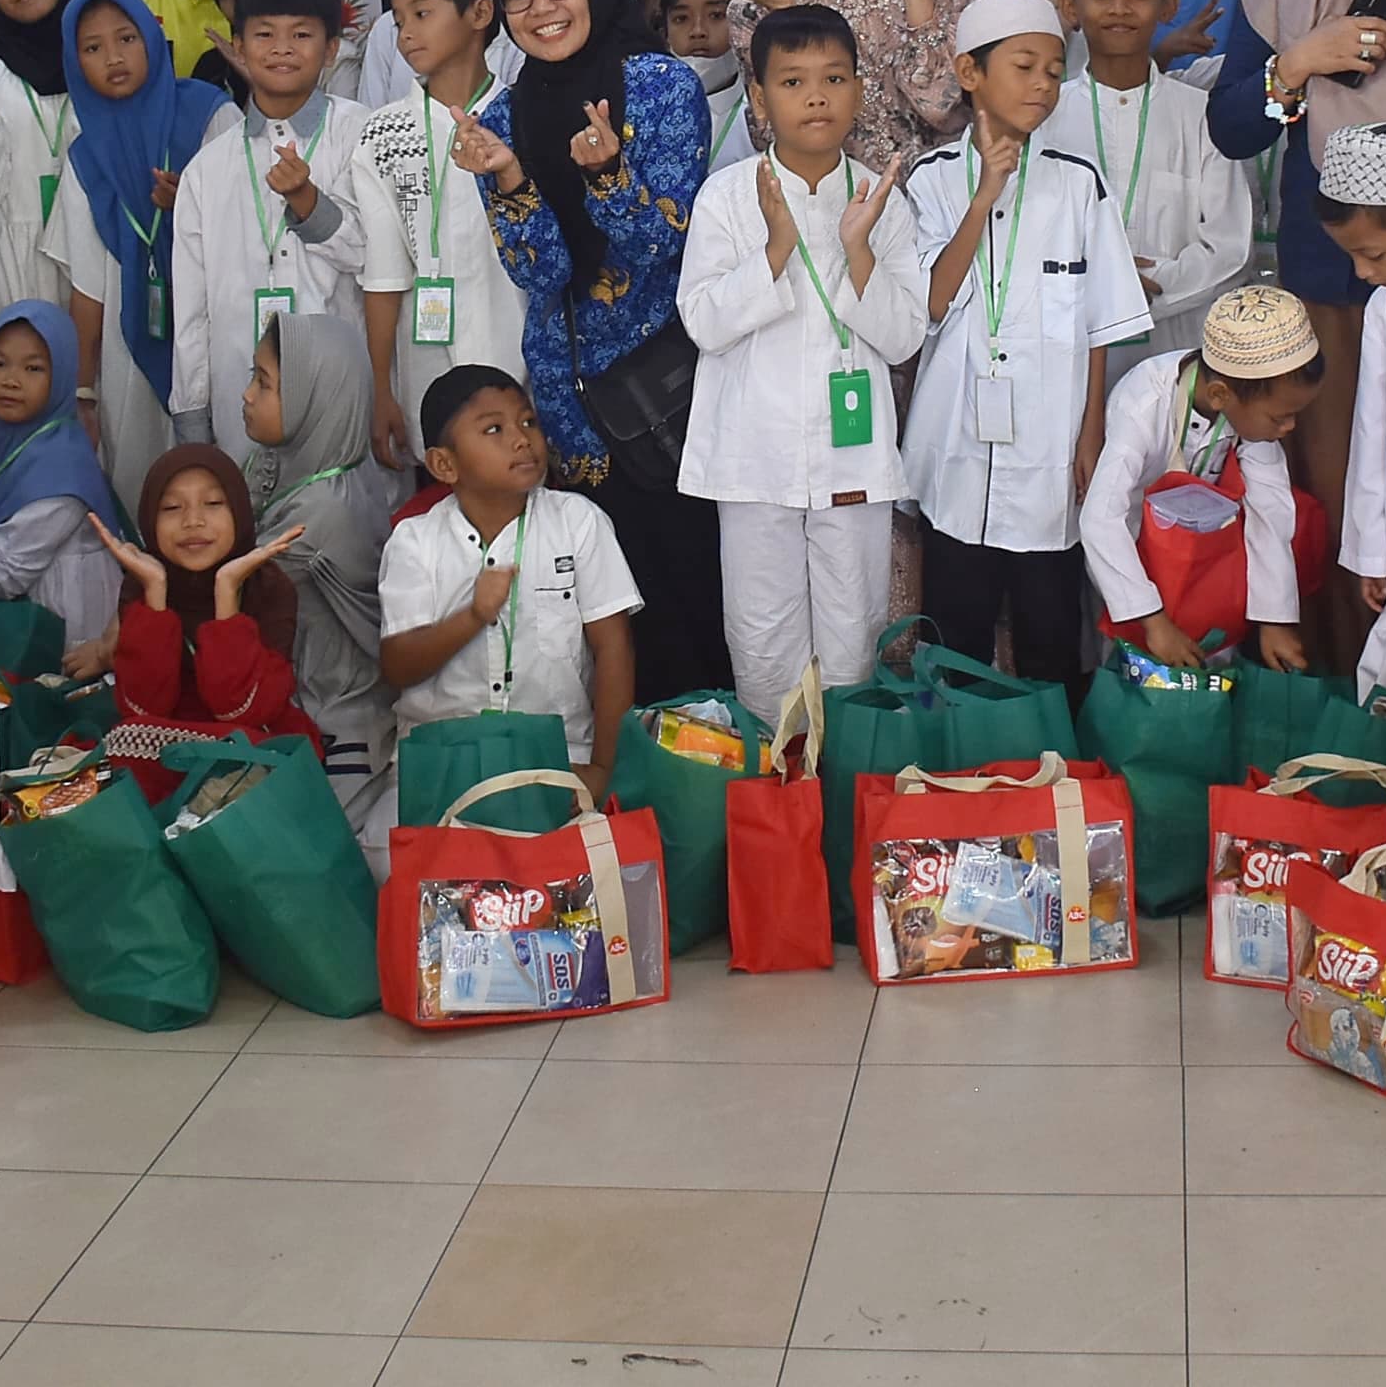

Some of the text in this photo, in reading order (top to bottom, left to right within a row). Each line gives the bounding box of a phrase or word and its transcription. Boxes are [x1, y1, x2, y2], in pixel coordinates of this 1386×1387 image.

[913, 851, 956, 894] Sii
[609, 941, 628, 955] ABC
[553, 952, 570, 989] SOS
